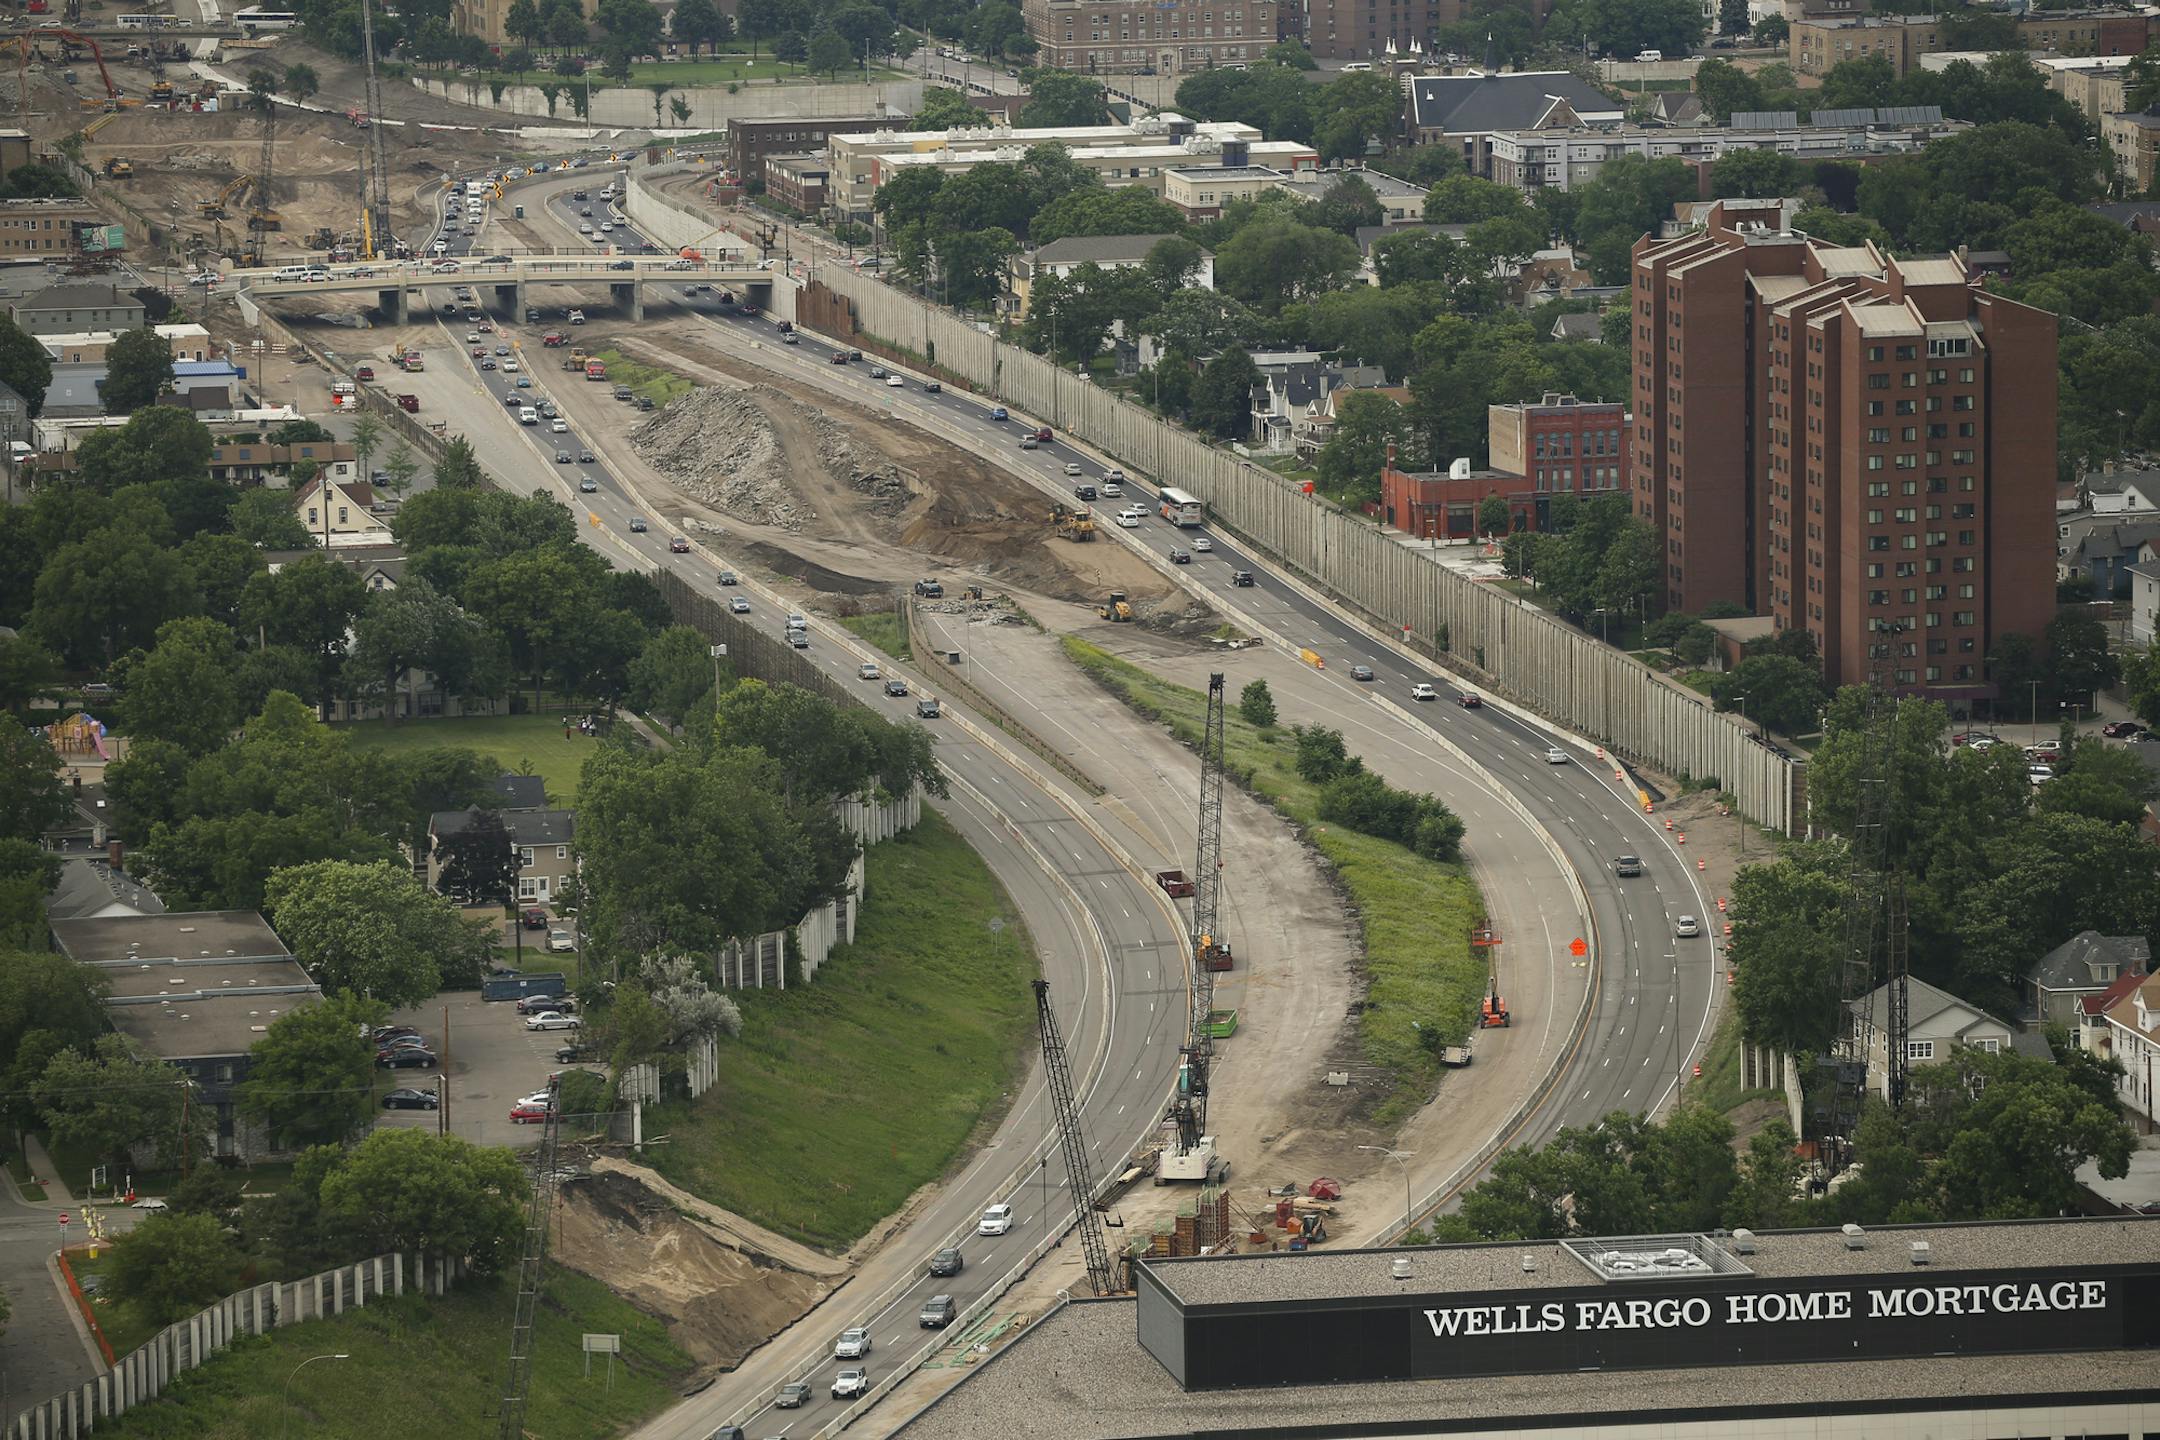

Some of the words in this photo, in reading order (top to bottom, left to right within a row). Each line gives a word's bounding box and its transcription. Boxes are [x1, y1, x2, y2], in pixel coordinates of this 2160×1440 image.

[1424, 1303, 1566, 1337] WELLS
[1576, 1298, 1711, 1331] FARGO
[1725, 1291, 1852, 1324] HOME
[1867, 1280, 2107, 1318] MORTGAGE
